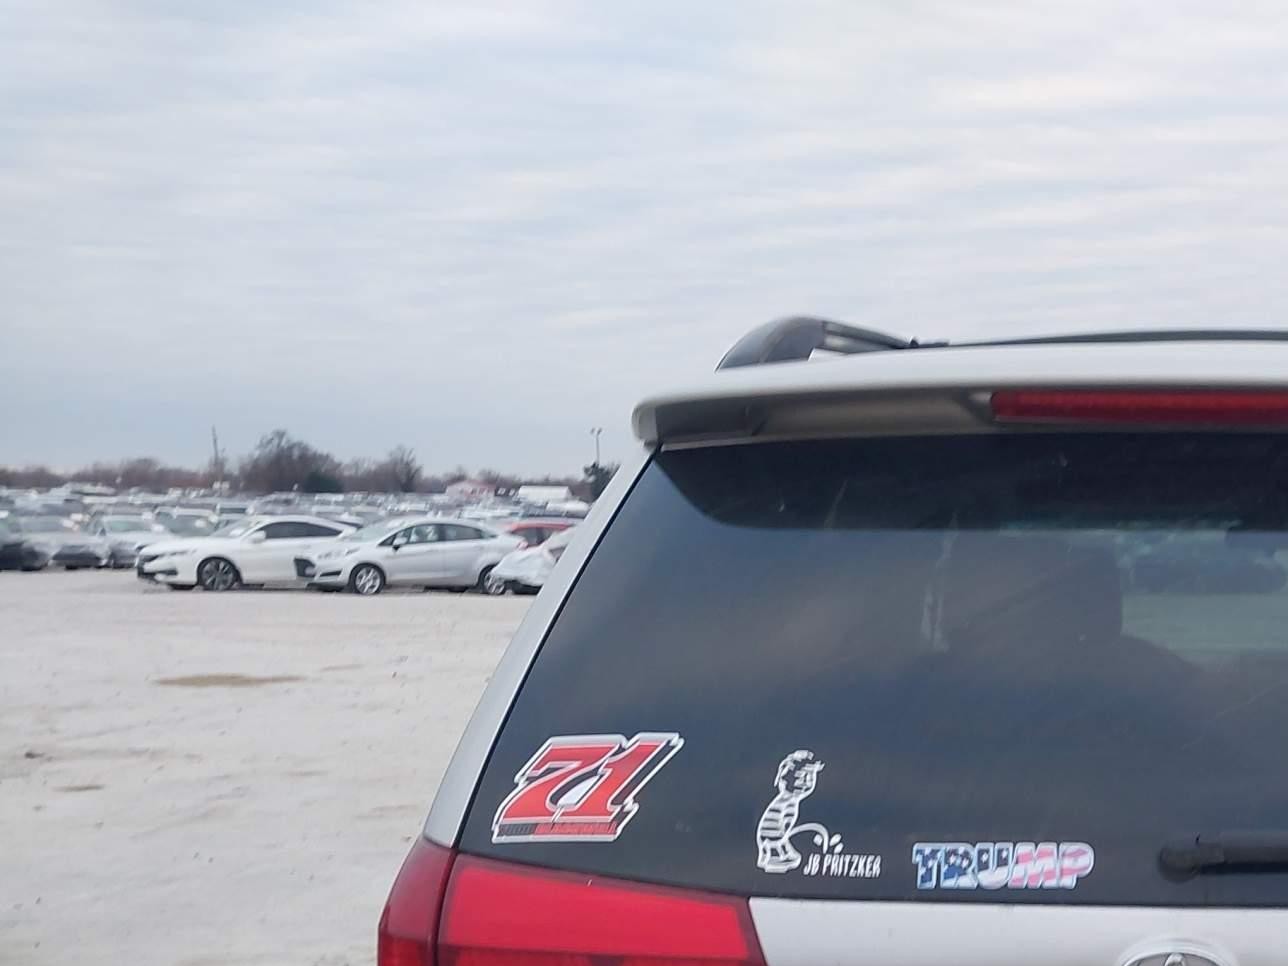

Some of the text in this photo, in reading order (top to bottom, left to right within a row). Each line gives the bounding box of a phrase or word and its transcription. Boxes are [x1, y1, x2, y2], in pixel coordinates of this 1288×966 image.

[494, 733, 682, 830] 71
[803, 853, 881, 878] JB PRITZKER
[912, 842, 1094, 890] TRUMP
